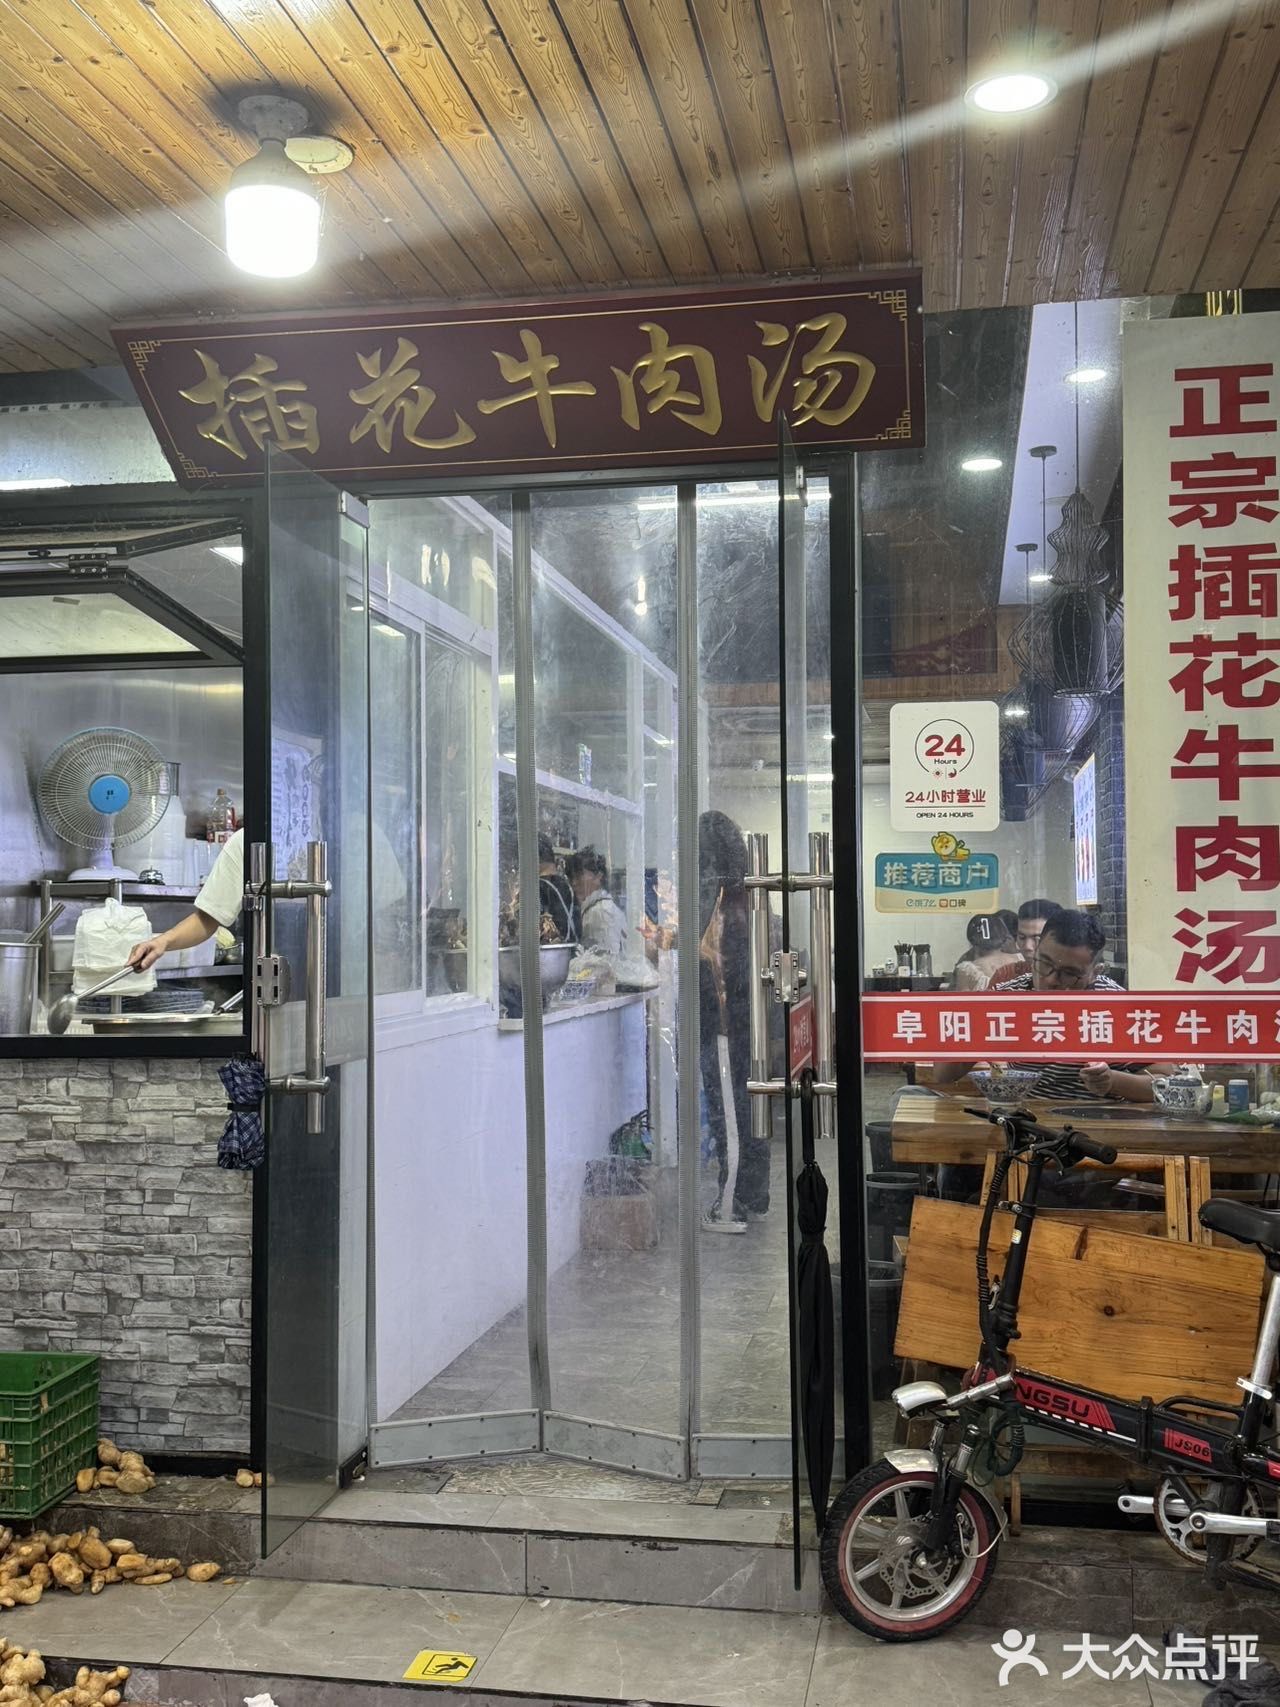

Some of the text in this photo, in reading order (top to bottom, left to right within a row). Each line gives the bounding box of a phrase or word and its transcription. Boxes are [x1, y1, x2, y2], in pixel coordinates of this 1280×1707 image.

[178, 312, 876, 458] 插花牛肉汤
[1167, 362, 1280, 984] 正宗插花牛肉汤
[924, 733, 966, 757] 24
[905, 789, 986, 803] 24小时营业
[883, 862, 989, 886] 推荐商户
[892, 1009, 1280, 1044] 阜阳正宗插花牛肉
[1174, 1437, 1210, 1458] JS06
